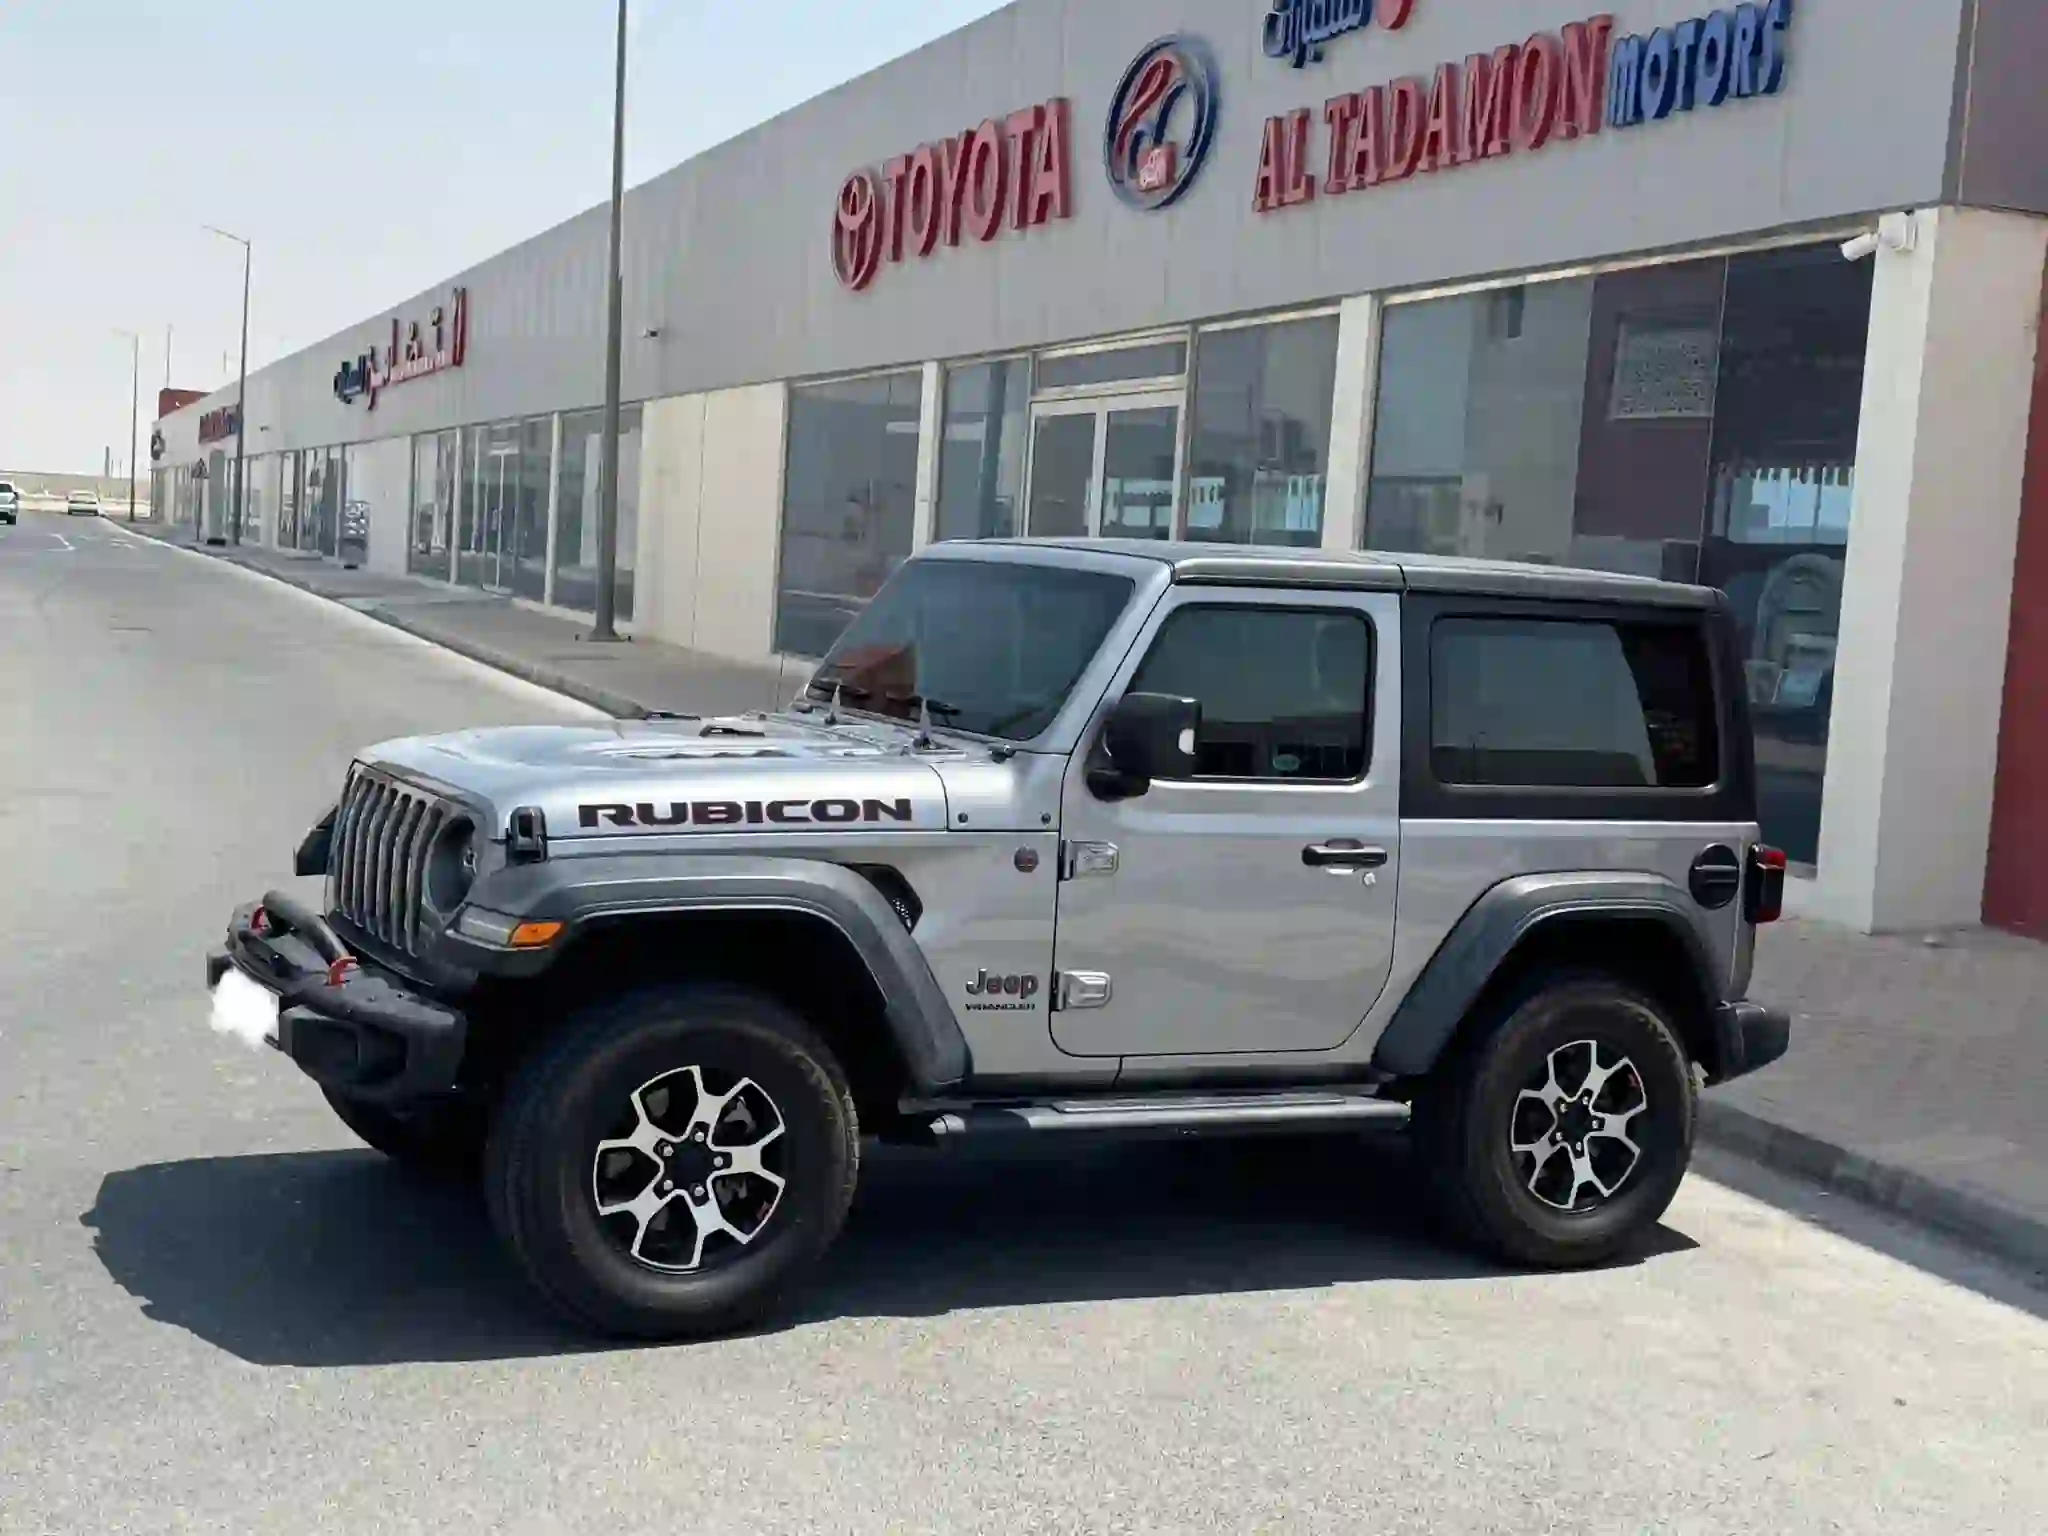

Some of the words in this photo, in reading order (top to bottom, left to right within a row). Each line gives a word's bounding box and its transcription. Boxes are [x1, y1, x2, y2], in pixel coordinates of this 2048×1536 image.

[1253, 107, 1315, 212] AL
[1324, 15, 1612, 195] TADAMON
[1608, 0, 1792, 127] MOTORS
[884, 97, 1072, 262] TOYOTA
[578, 798, 912, 828] RUBICON
[966, 967, 1039, 999] Jeep
